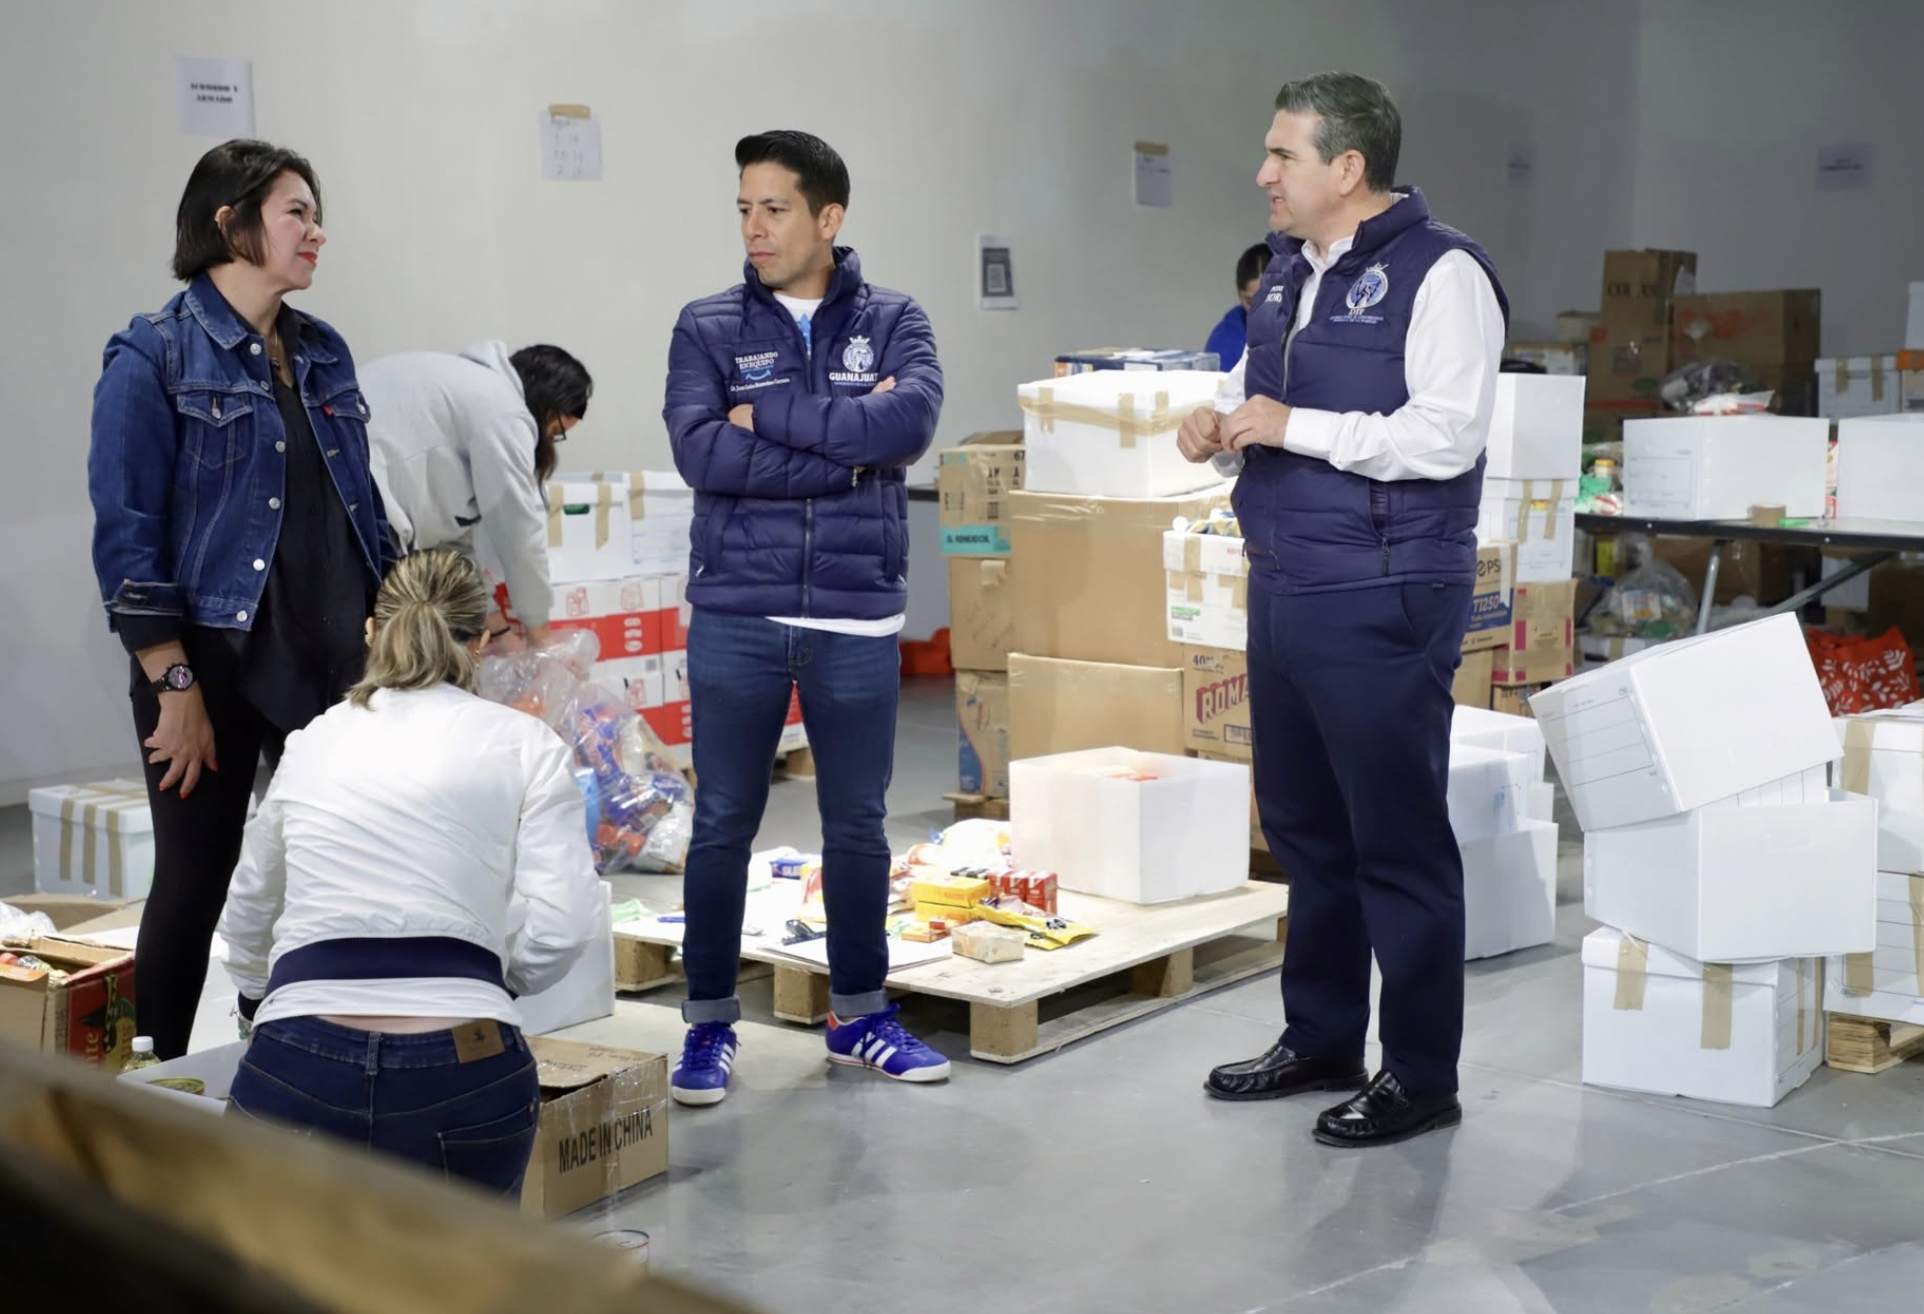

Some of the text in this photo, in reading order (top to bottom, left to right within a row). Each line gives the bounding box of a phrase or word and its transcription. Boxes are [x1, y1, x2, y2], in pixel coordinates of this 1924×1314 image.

[735, 351, 778, 364] TRABAJANDO
[829, 371, 878, 382] GUANAJUAT
[559, 1106, 654, 1173] MADE IN CHINA
